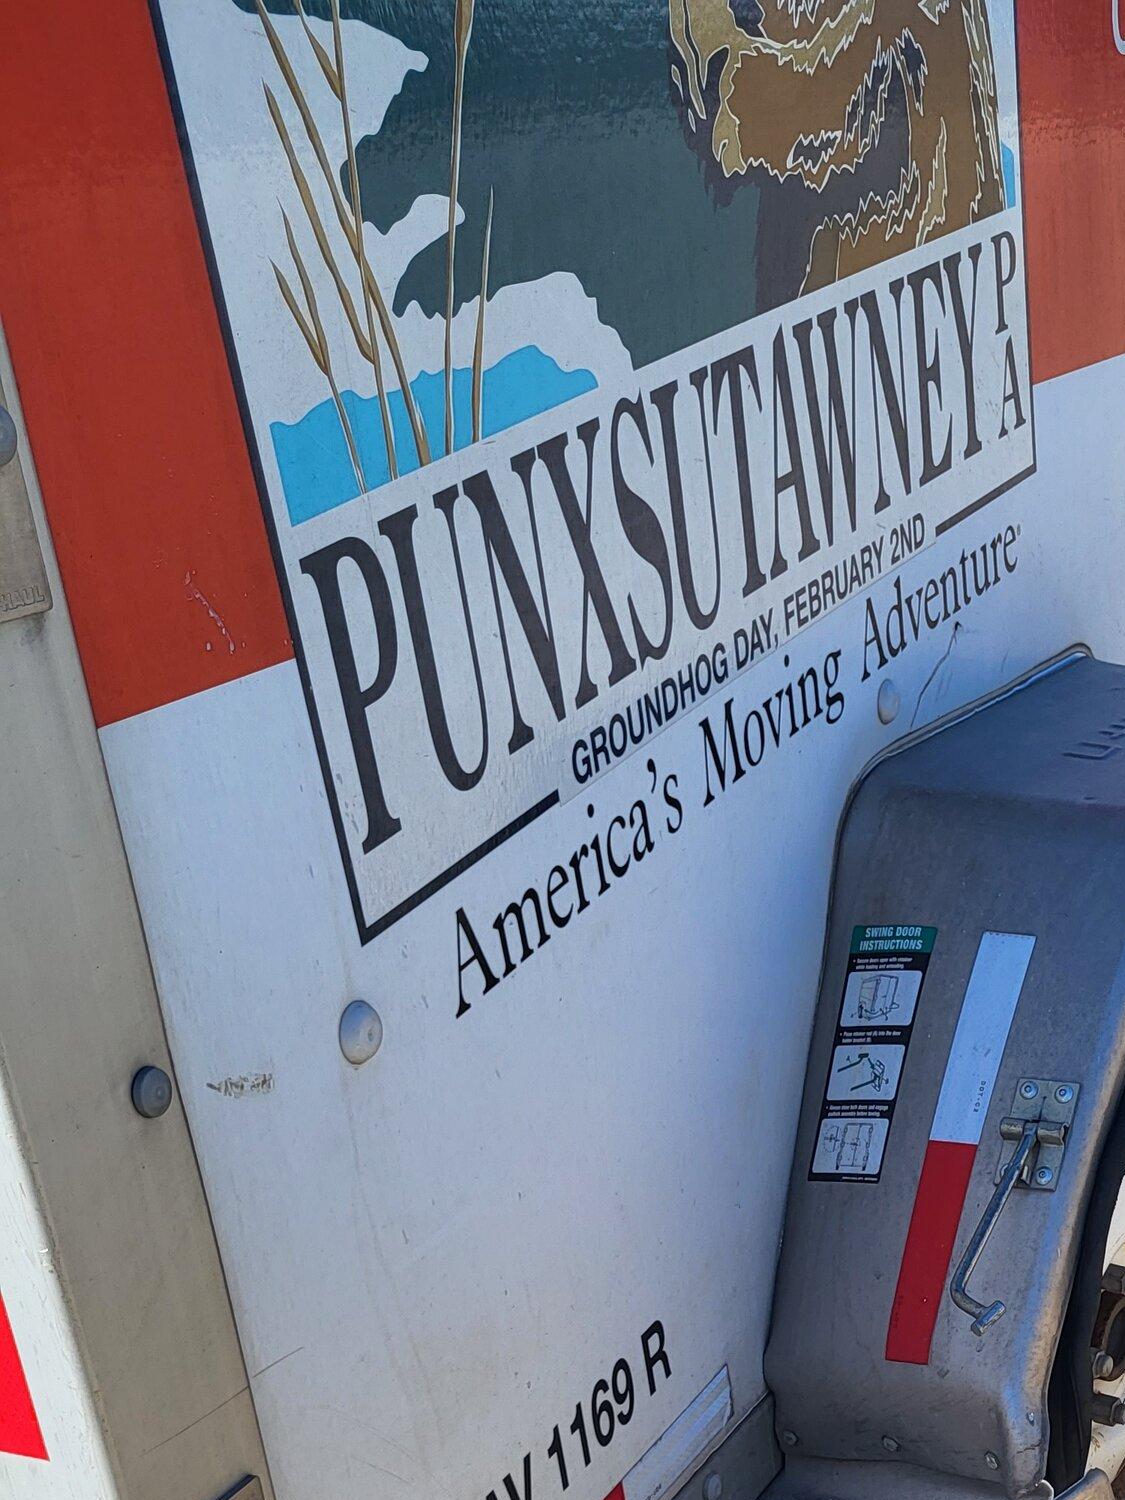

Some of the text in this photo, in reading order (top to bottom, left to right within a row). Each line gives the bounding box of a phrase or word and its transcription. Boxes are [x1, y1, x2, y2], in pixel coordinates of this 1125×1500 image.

[299, 242, 984, 854] PUNXSUTAWNEY
[571, 513, 926, 783] GROUNDHOG DAY, FEBRUARY 2ND
[455, 527, 1018, 1019] America's Moving Adventure
[859, 939, 923, 951] INSTRUCTIONS
[865, 927, 921, 937] SWING DOOR
[547, 1358, 634, 1491] 1169
[640, 1319, 672, 1397] R
